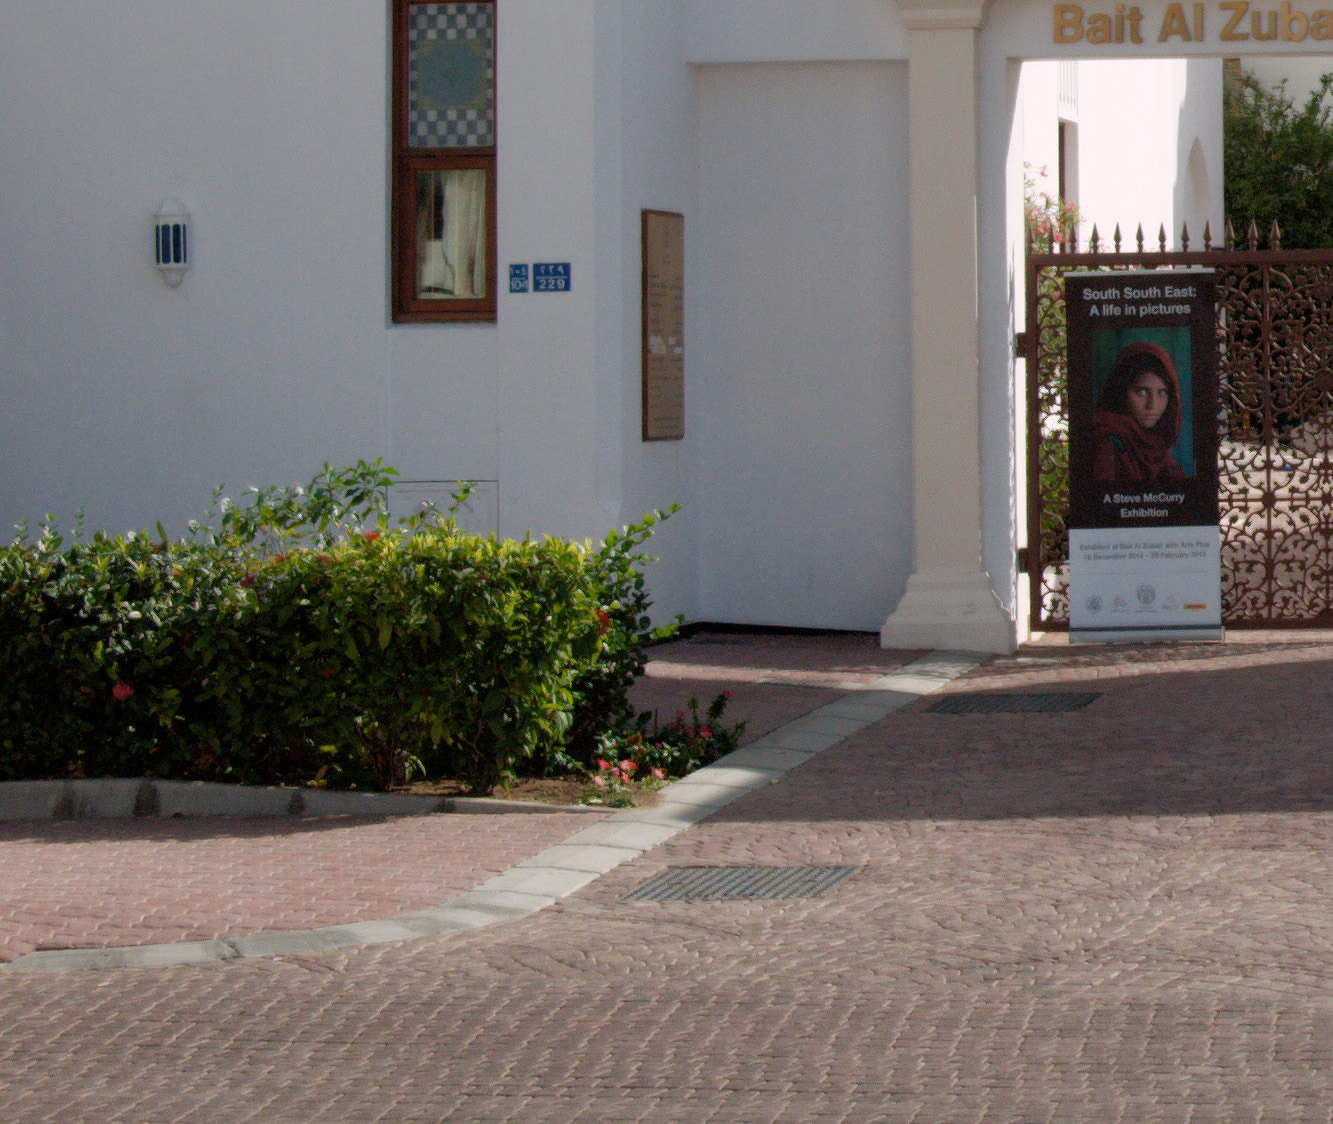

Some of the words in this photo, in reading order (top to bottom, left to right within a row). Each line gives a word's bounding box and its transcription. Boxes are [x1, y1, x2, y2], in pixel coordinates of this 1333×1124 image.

[1053, 3, 1143, 44] Bait
[1158, 2, 1203, 42] Al
[511, 279, 528, 290] 104
[539, 278, 566, 289] 229
[1083, 287, 1120, 300] South
[1123, 286, 1161, 299] South
[1164, 286, 1197, 298] East:
[1089, 304, 1100, 316] A
[1102, 304, 1121, 316] life
[1125, 303, 1136, 315] in
[1140, 302, 1191, 317] pictures
[1103, 494, 1112, 504] A
[1113, 493, 1141, 504] Steve
[1143, 492, 1185, 504] McCurry
[1120, 507, 1168, 518] Exhibition
